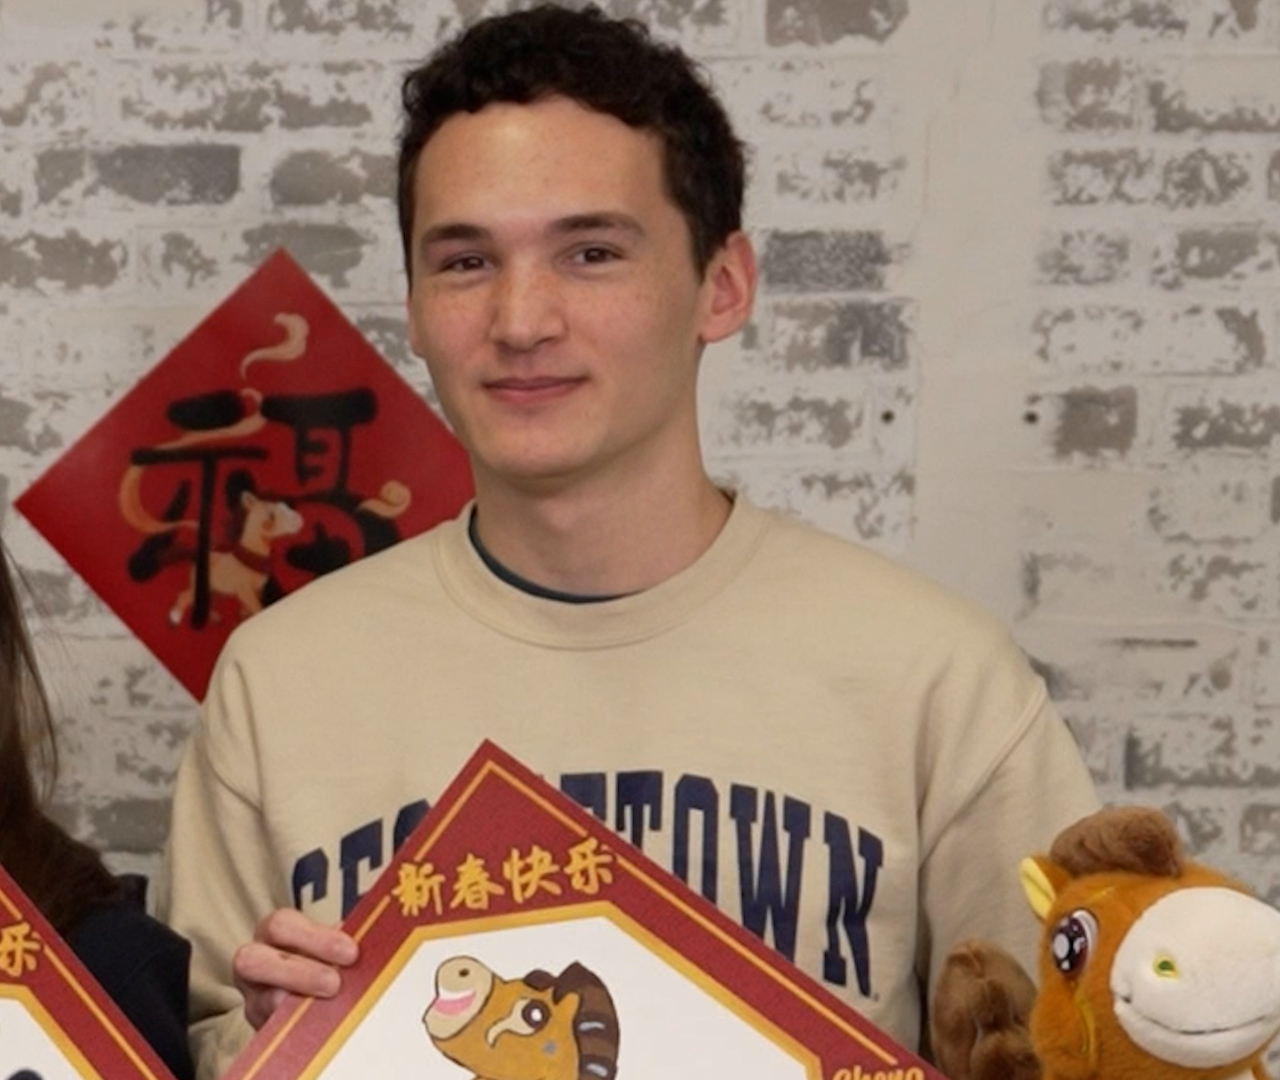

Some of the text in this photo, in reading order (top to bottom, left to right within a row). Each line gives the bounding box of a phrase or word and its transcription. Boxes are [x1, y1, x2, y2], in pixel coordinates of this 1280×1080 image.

[127, 386, 403, 631] 福
[392, 836, 617, 917] 新春快乐
